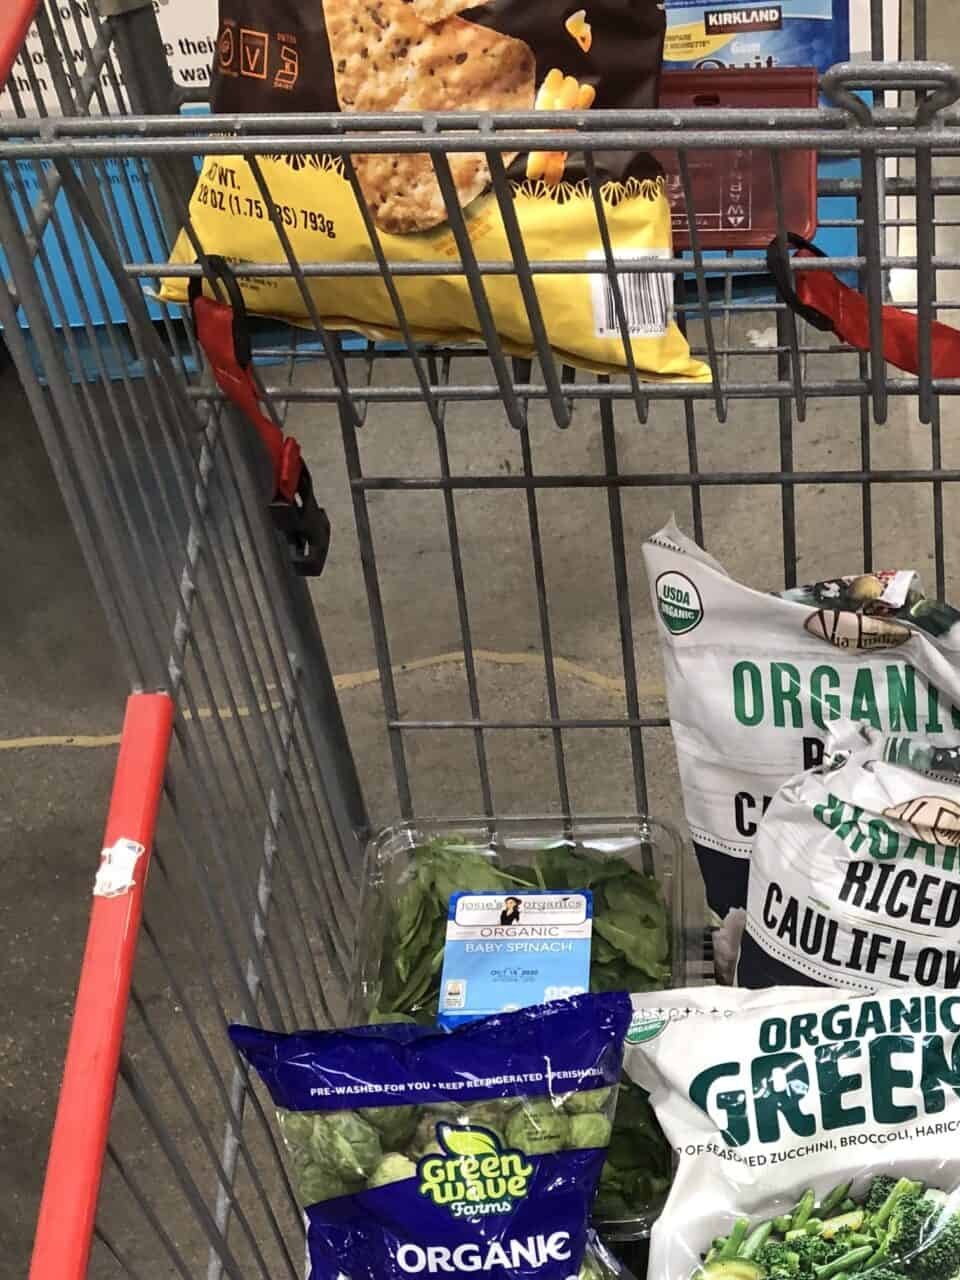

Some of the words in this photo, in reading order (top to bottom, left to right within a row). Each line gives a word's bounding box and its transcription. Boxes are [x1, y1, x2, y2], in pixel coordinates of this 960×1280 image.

[708, 9, 780, 26] KIRKLAND
[217, 165, 241, 190] WT.
[210, 189, 226, 211] OZ
[228, 194, 263, 220] (1.75
[300, 209, 336, 239] 793g
[662, 584, 691, 606] USDA
[480, 926, 560, 938] ORGANIC
[465, 942, 504, 953] BABY
[505, 942, 573, 953] SPINACH
[310, 1083, 382, 1097] PRE-WASHED
[384, 1081, 406, 1093] FOR
[407, 1081, 430, 1091] YOU
[438, 1081, 465, 1090] KEEP
[685, 1144, 704, 1157] OF
[769, 1139, 838, 1164] ZUCCHINI,
[839, 1130, 913, 1149] BROCCOLI,
[421, 1151, 533, 1184] Green
[450, 1199, 512, 1218] Farms
[396, 1231, 572, 1274] ORGANIC
